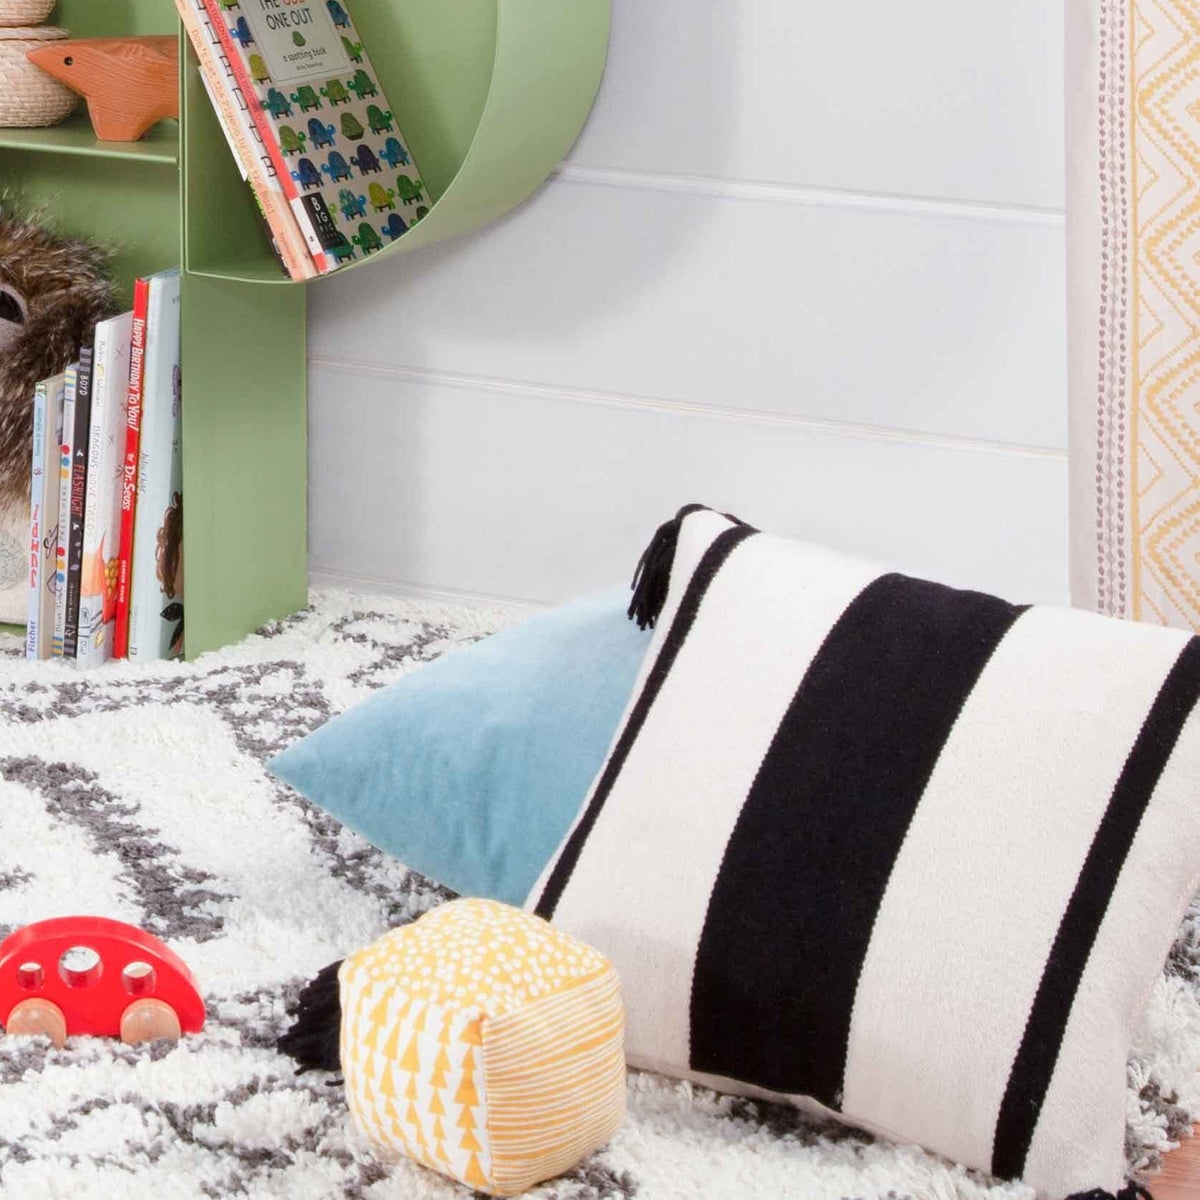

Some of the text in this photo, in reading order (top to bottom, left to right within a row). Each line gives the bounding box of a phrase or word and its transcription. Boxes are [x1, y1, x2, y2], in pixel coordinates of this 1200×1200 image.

[265, 7, 314, 30] ONE OUT
[79, 374, 89, 396] BOYD
[90, 425, 101, 469] DRAGONS
[124, 464, 136, 482] Dr.
[70, 464, 85, 517] FLASHLIGHT
[122, 482, 135, 511] Seuss
[28, 620, 37, 652] Fischer
